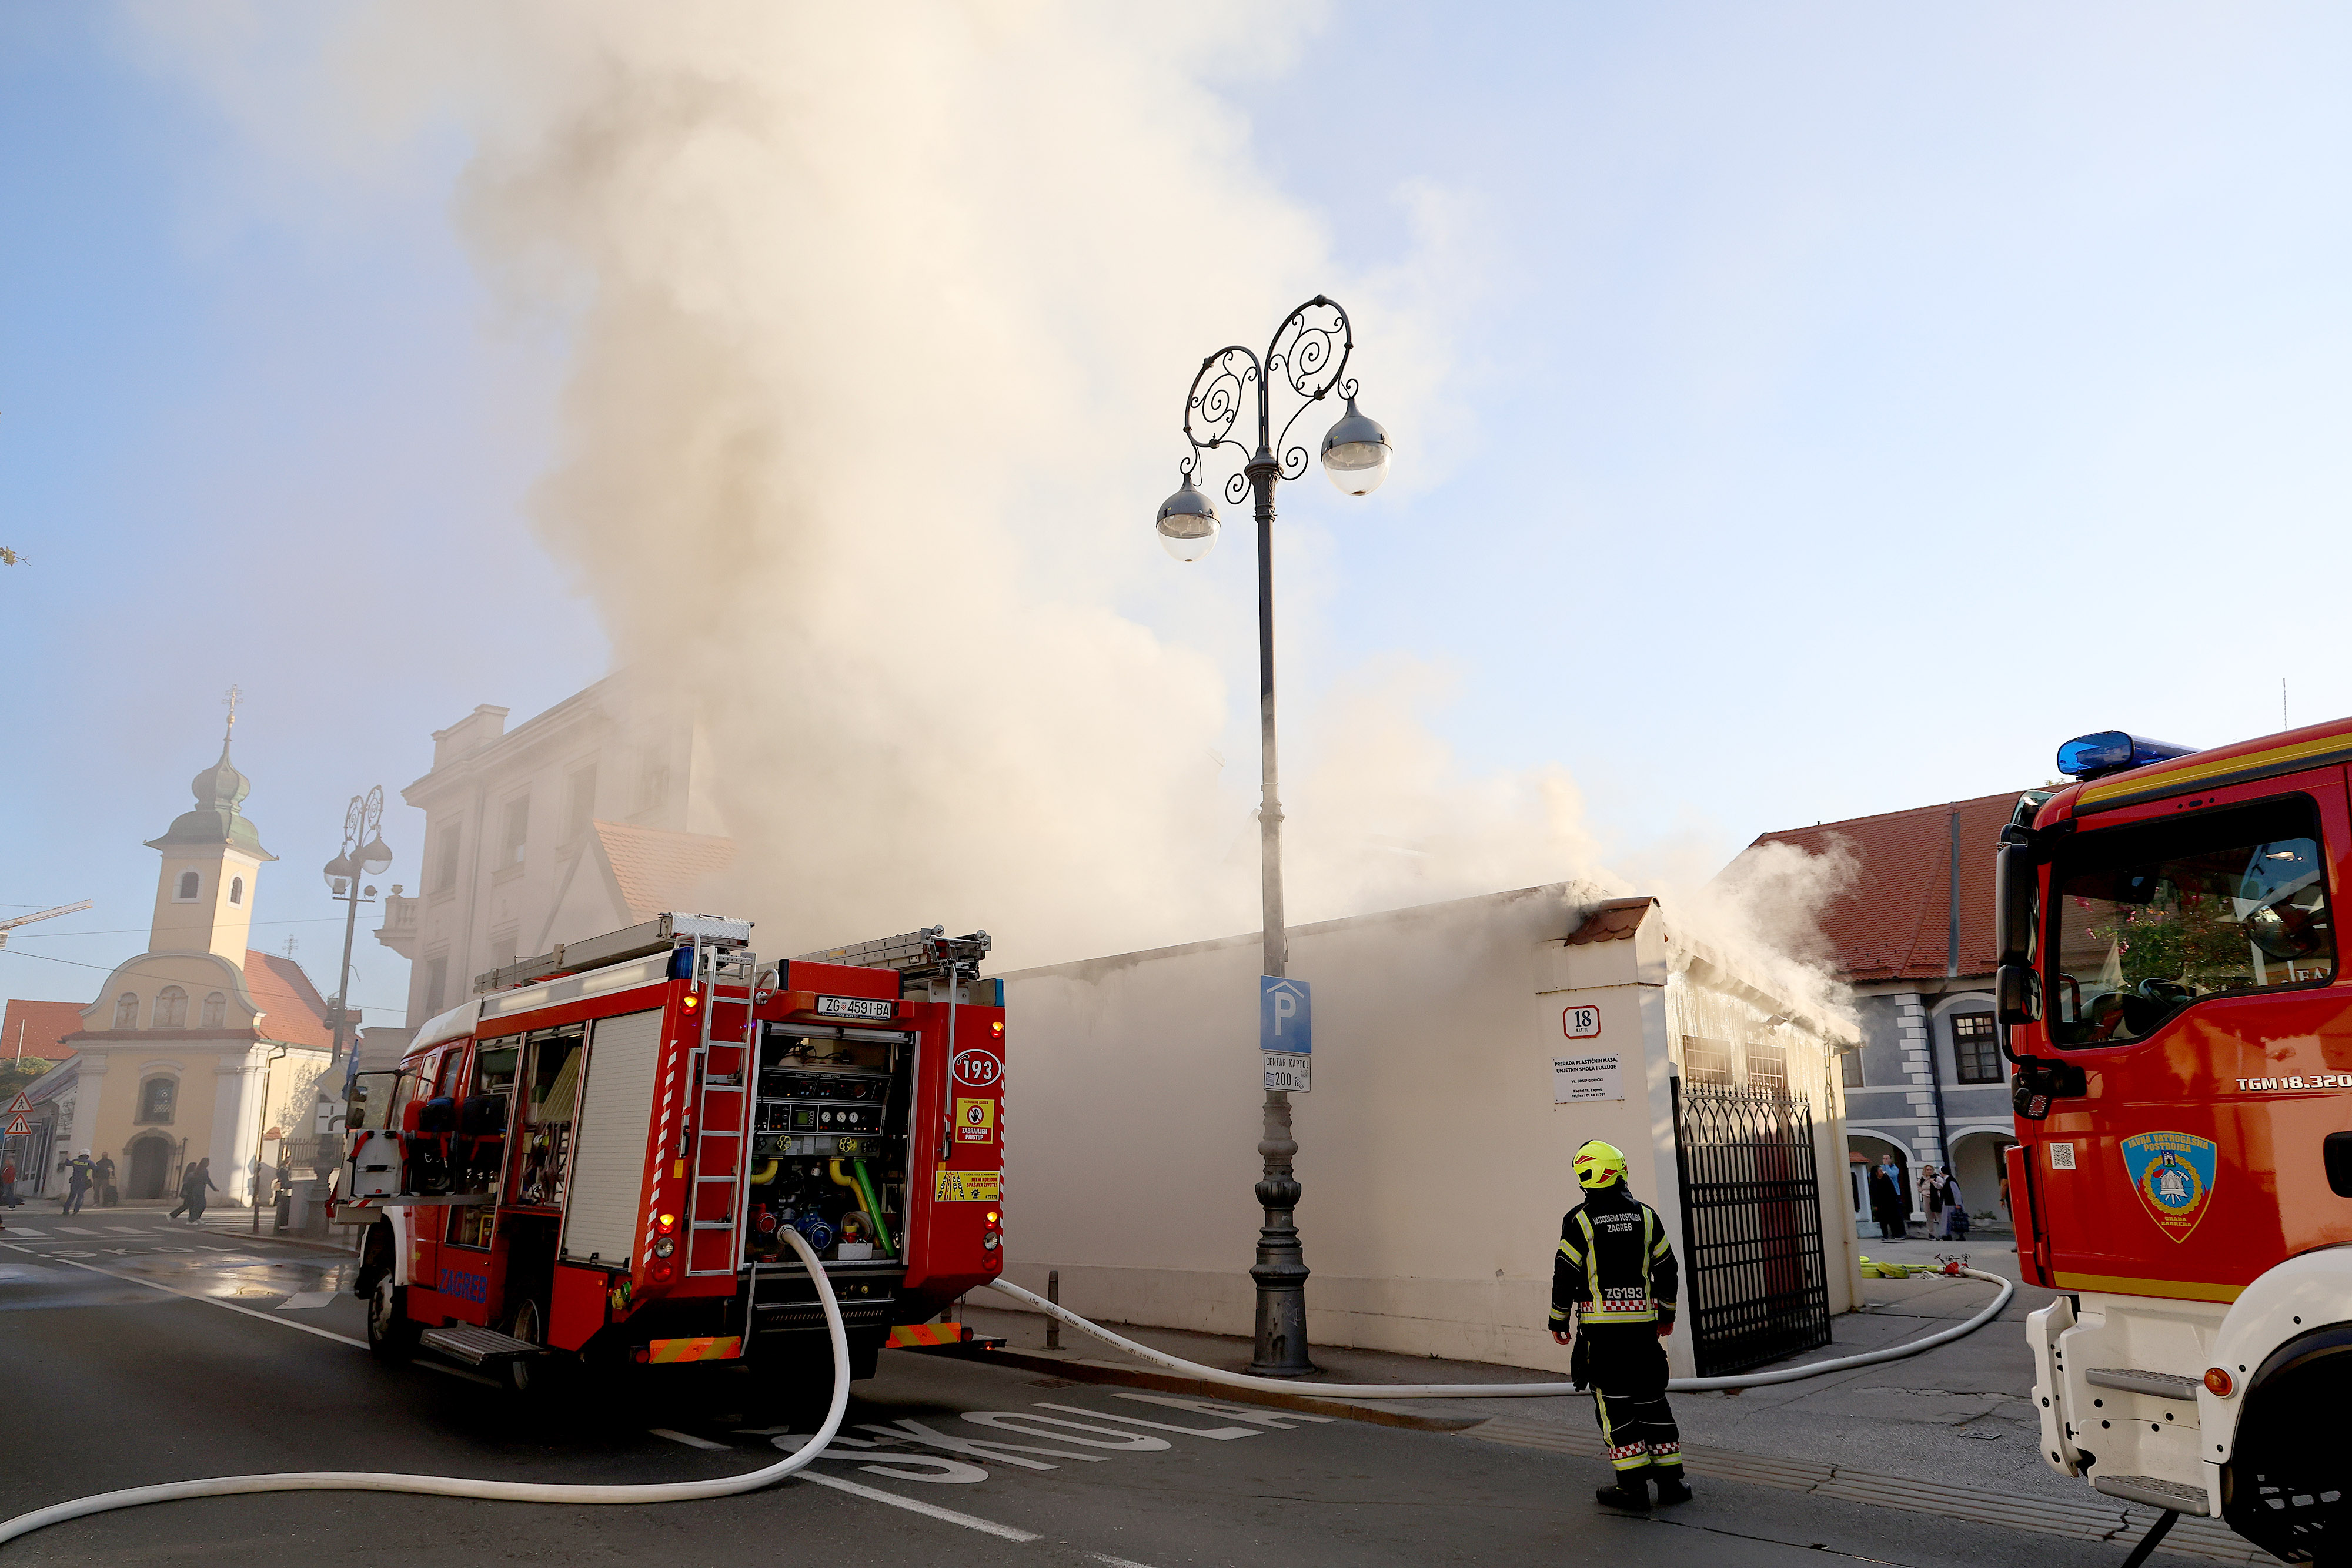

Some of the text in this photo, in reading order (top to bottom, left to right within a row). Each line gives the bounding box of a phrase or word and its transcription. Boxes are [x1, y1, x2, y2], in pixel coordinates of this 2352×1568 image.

[826, 999, 840, 1012] ZG
[1275, 991, 1297, 1036] P
[1575, 1010, 1592, 1027] 18
[963, 1060, 993, 1079] 193
[1266, 1057, 1309, 1069] CENTAR KAPTOL
[1275, 1072, 1291, 1086] 200
[2236, 1075, 2352, 1090] TGM 18.320
[2128, 1134, 2209, 1150] JAVNA VATROGASNA
[2143, 1142, 2191, 1152] POSTROJBA
[1592, 1214, 1620, 1225] VATROGASNA
[1607, 1223, 1633, 1233] ZAGREB
[439, 1268, 487, 1303] ZAGREB
[1605, 1287, 1643, 1299] ZG193
[1064, 1315, 1079, 1326] Made
[1094, 1330, 1121, 1346] Germany
